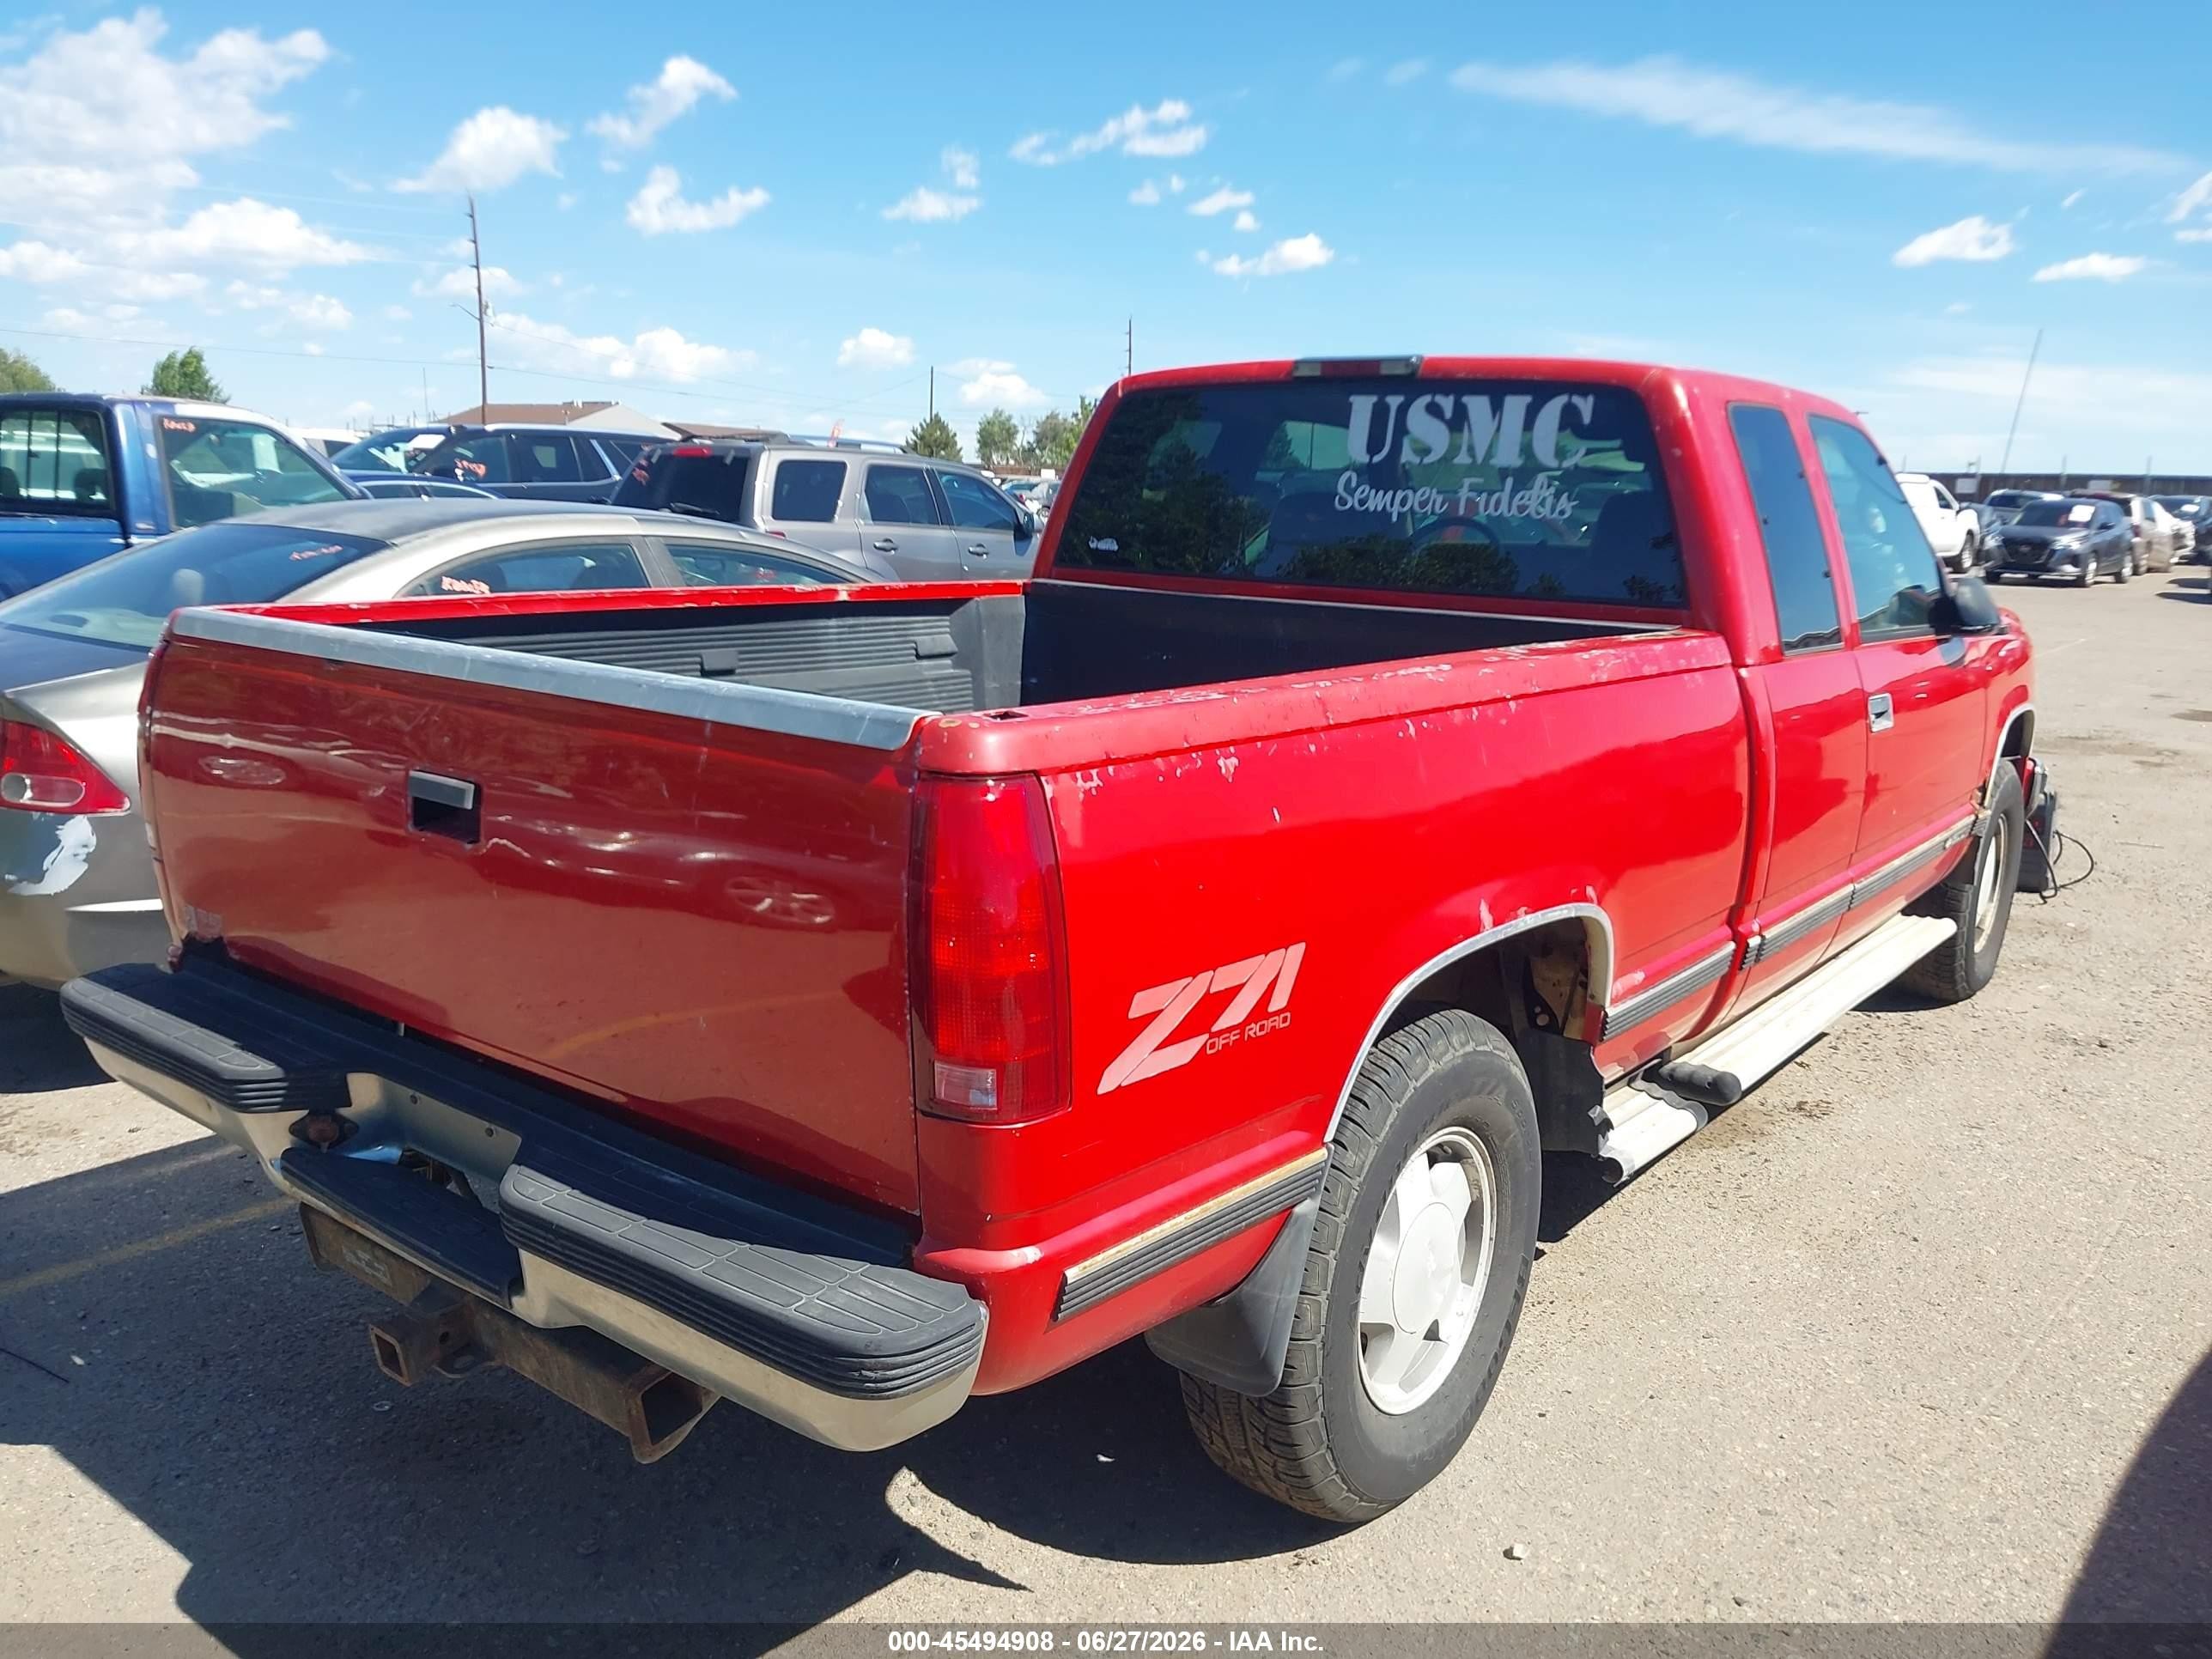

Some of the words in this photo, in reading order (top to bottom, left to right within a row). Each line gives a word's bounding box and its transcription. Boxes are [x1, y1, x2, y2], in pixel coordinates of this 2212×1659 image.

[1347, 392, 1595, 469] USMC
[1334, 470, 1449, 522] Semper
[1457, 470, 1580, 520] Fidelis
[1097, 941, 1306, 1096] Z71
[1206, 1029, 1241, 1055] OFF
[1244, 1011, 1291, 1042] ROAD
